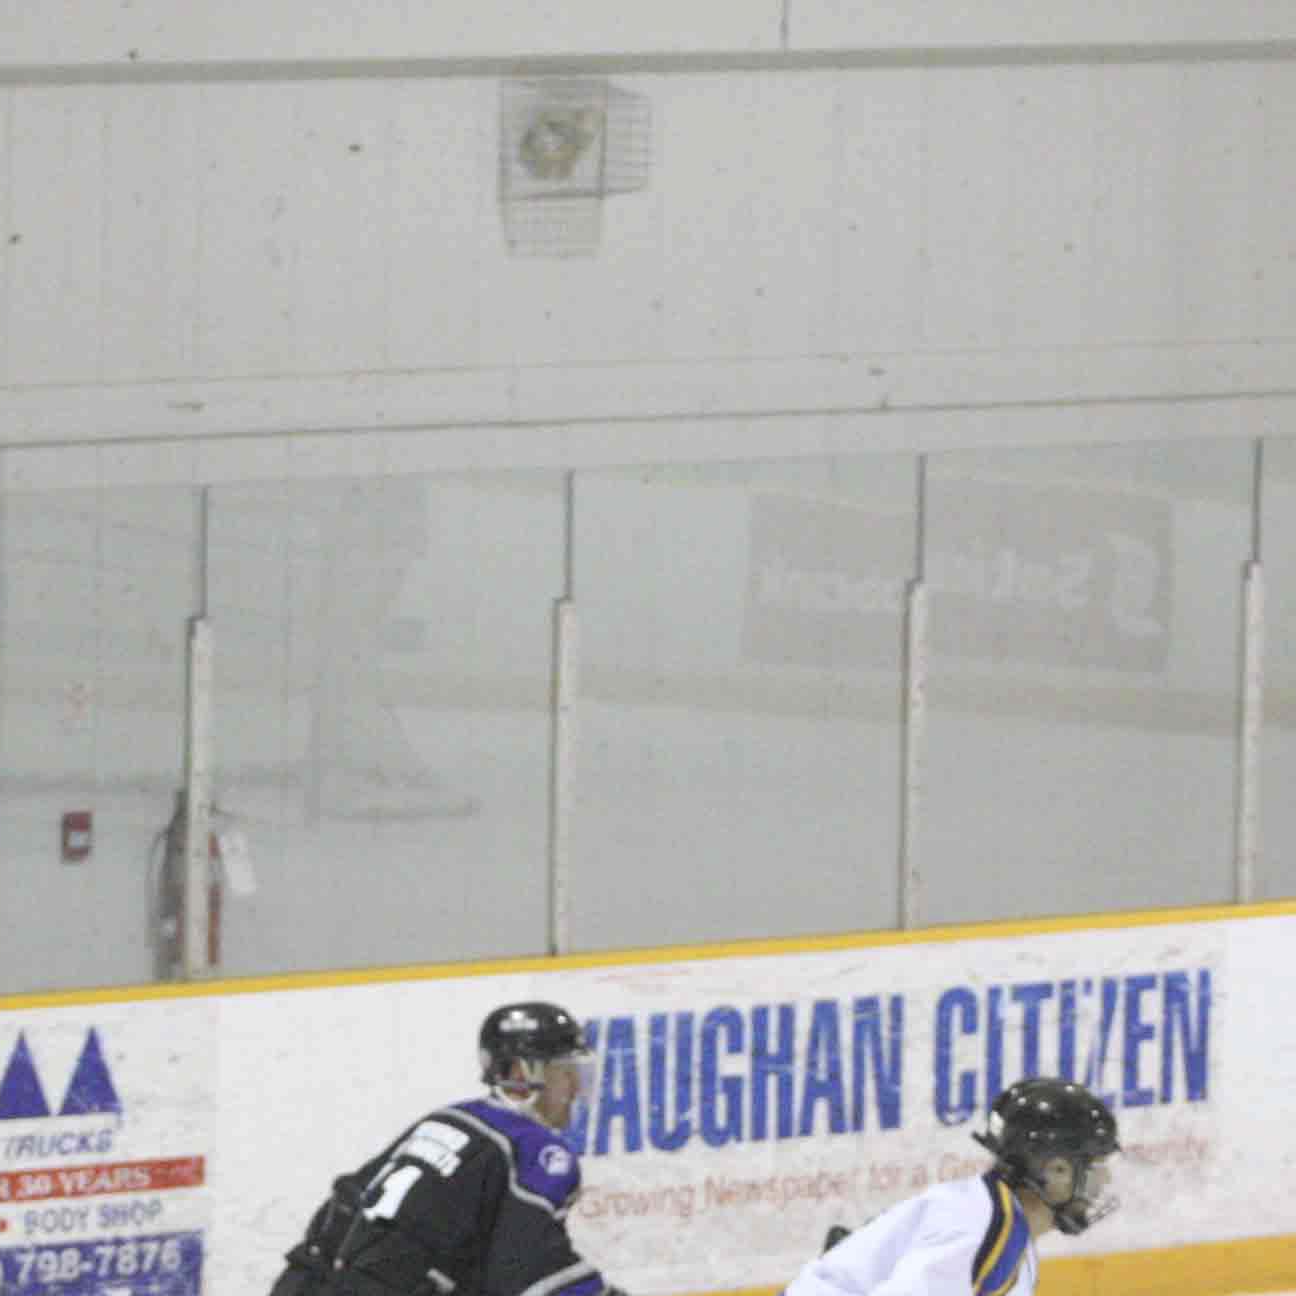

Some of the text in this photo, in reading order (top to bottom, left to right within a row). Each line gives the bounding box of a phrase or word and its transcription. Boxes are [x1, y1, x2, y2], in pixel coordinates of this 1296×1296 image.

[562, 967, 1211, 1156] VAUGHAN CITIZEN
[4, 1129, 114, 1159] TRUCKS
[60, 1166, 151, 1195] YEARS
[23, 1205, 89, 1235] BODY
[97, 1200, 163, 1228] SHOP
